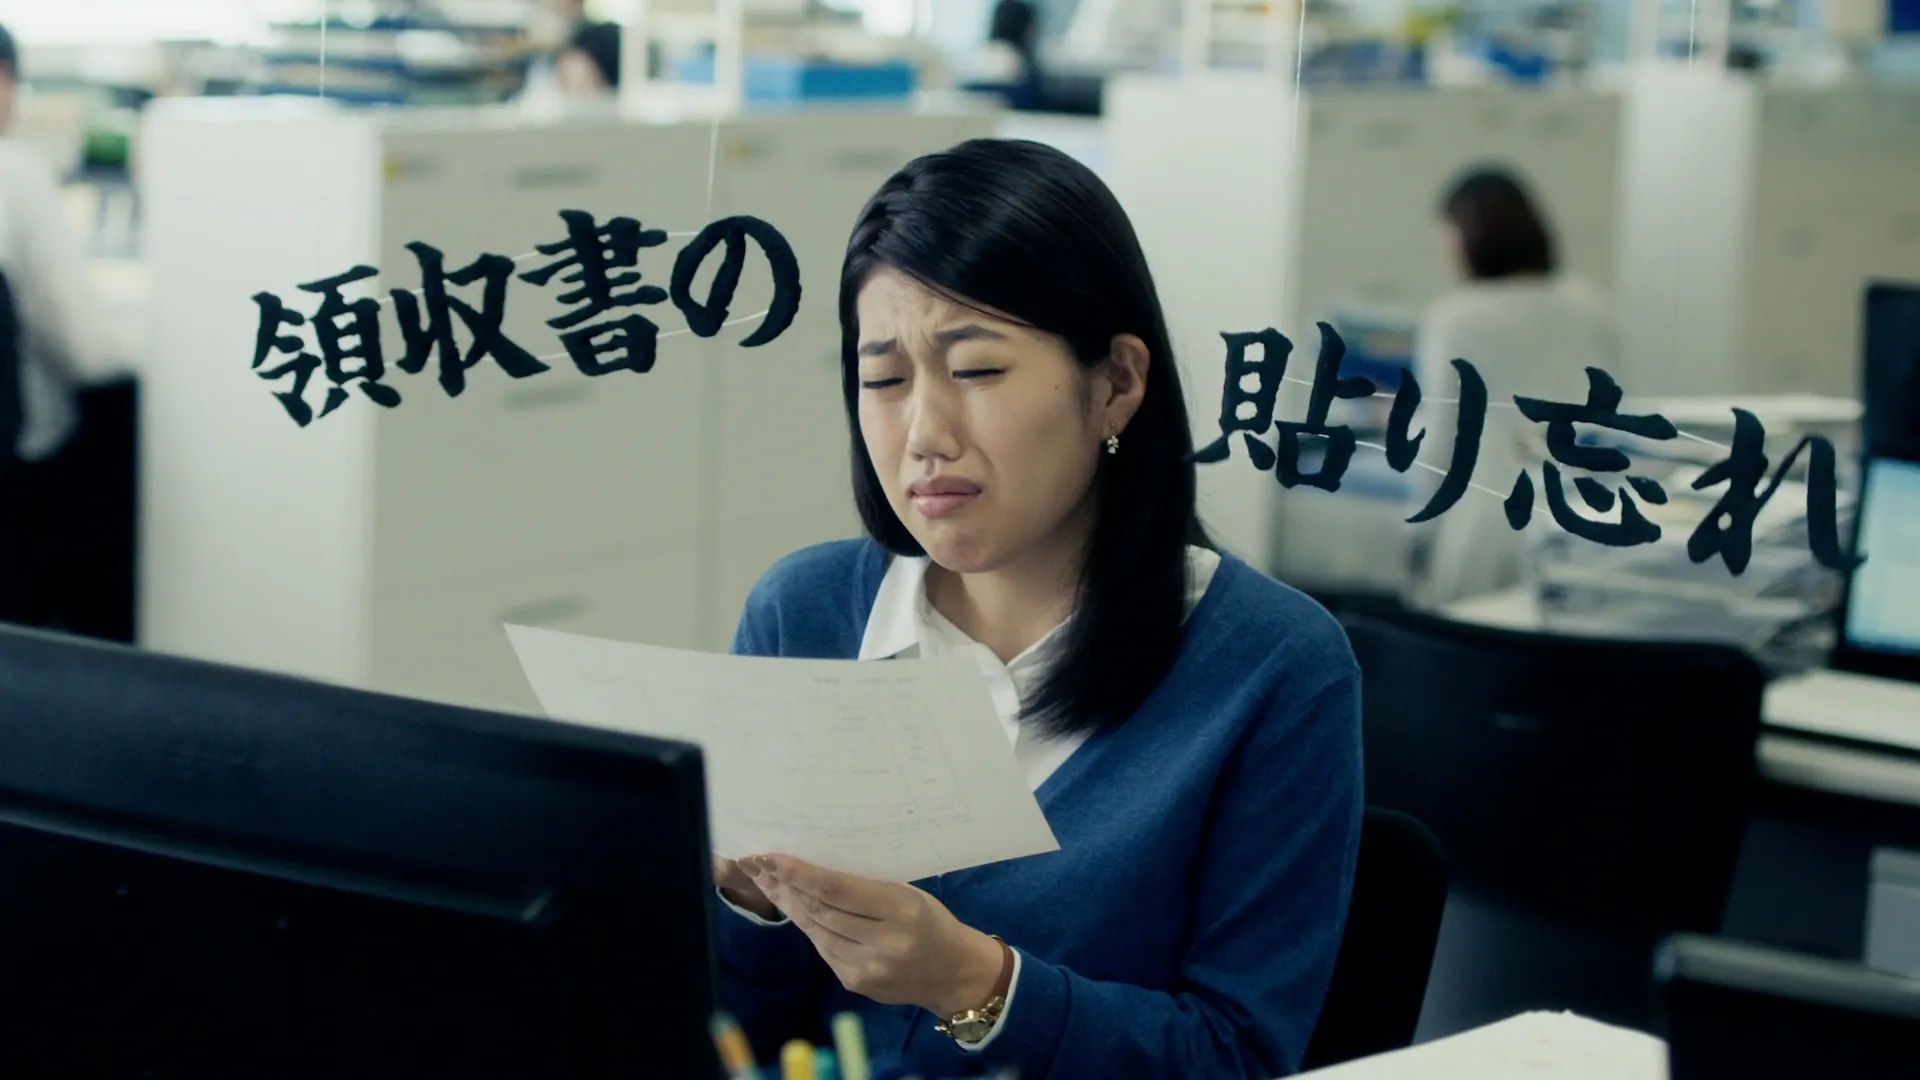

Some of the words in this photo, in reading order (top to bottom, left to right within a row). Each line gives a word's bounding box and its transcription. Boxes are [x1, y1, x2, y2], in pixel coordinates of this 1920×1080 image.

[251, 199, 802, 427] 領収書の
[1190, 321, 1866, 576] 貼り忘れ
